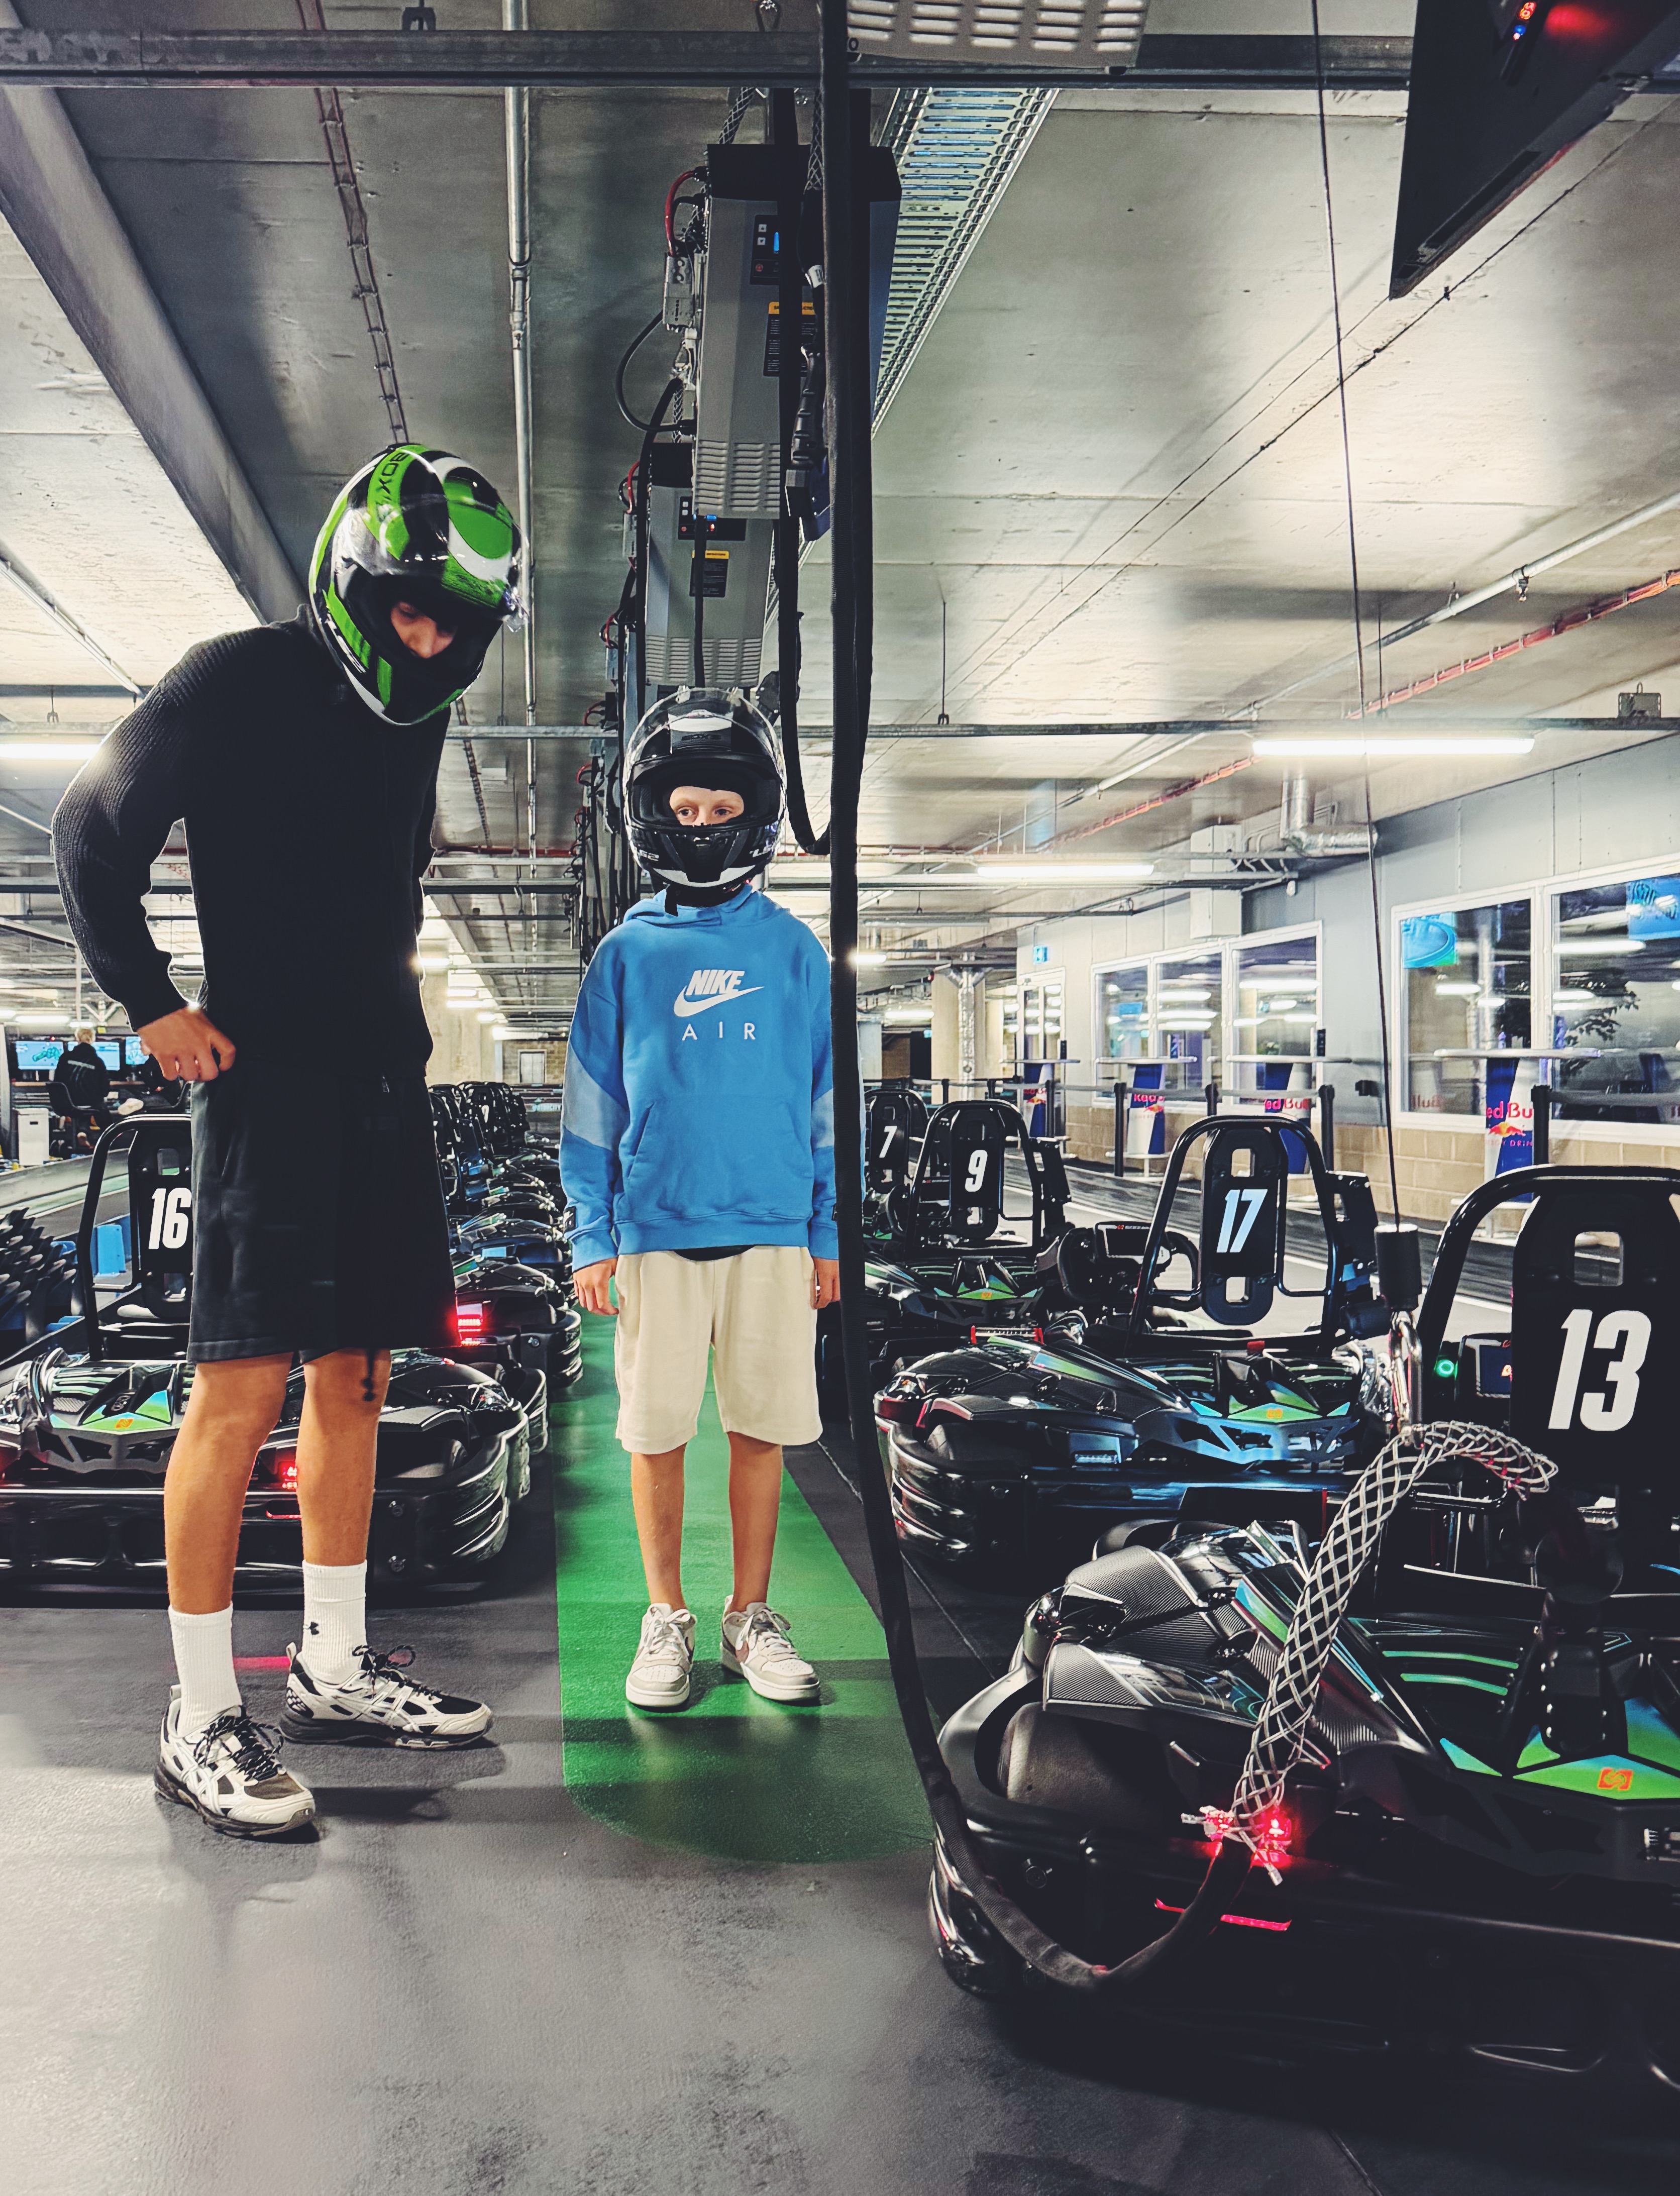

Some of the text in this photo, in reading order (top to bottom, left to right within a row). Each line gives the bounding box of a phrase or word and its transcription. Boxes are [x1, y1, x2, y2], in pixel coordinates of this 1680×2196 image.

[686, 969, 745, 996] NIKE
[682, 1021, 756, 1041] AIR
[1486, 1100, 1533, 1119] ed Bu
[879, 1125, 897, 1159] 7
[965, 1149, 988, 1192] 9
[148, 1187, 192, 1249] 16
[1216, 1189, 1268, 1253] 17
[1548, 1309, 1652, 1431] 13
